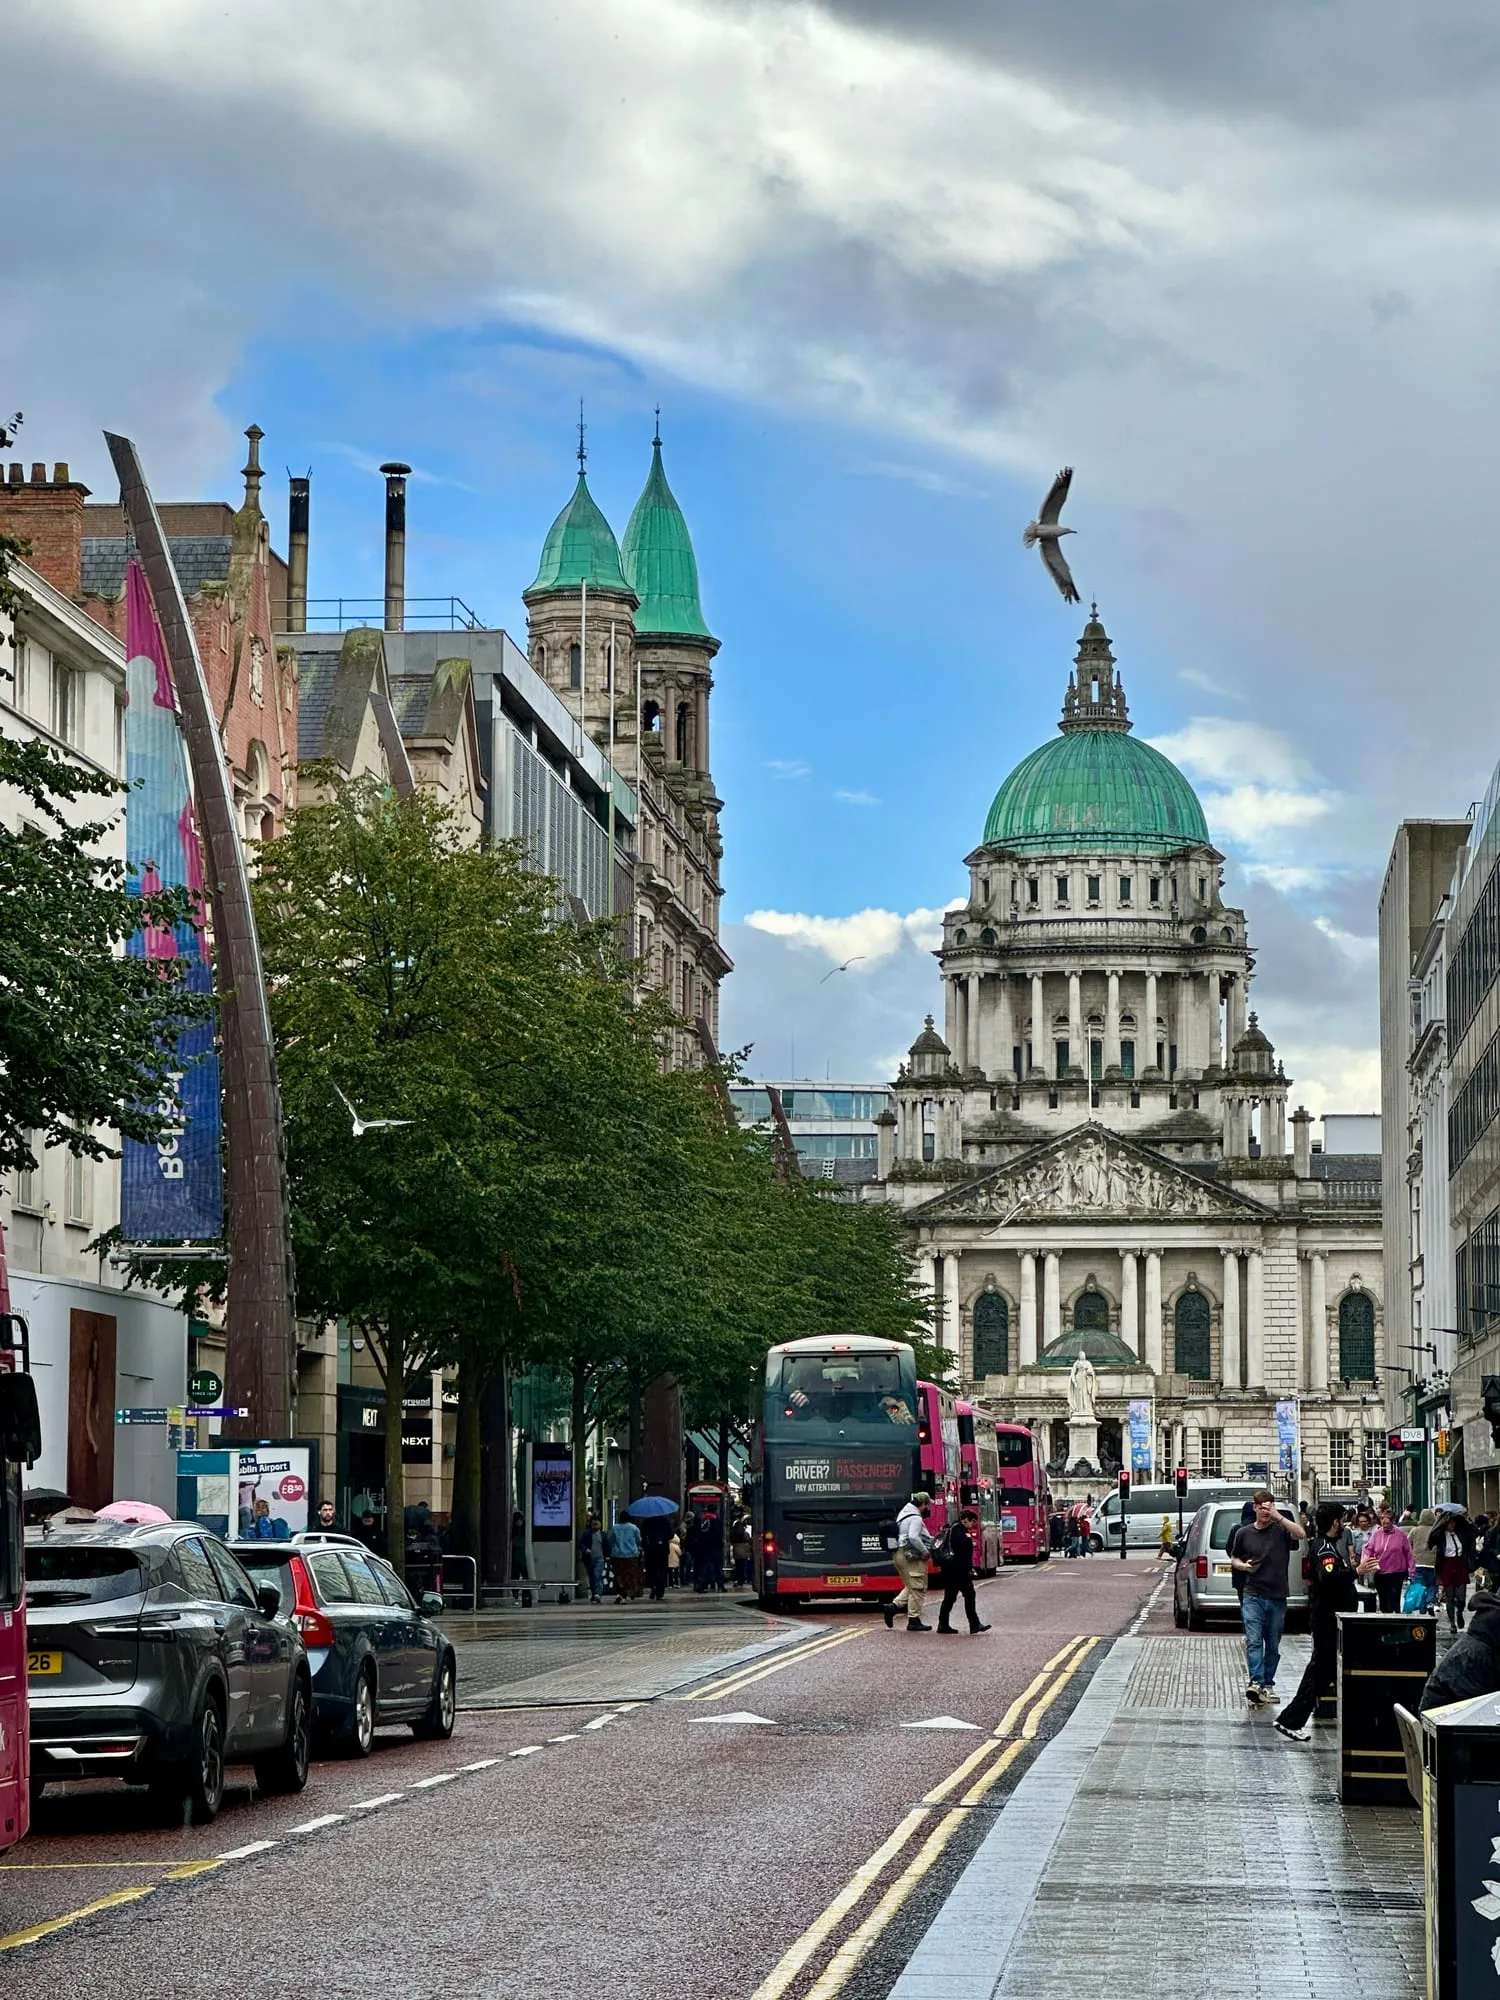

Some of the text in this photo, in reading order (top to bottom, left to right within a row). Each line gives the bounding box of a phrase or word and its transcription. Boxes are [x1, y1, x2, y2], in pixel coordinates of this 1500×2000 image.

[362, 1408, 378, 1427] NEXT
[1403, 1431, 1422, 1439] DV8
[401, 1437, 431, 1446] NEXT
[259, 1464, 287, 1473] Airport
[786, 1464, 903, 1480] DRIVER? PASSENGER?
[795, 1484, 807, 1492] PAY
[808, 1482, 841, 1492] ATTENTION
[28, 1654, 51, 1671] 26
